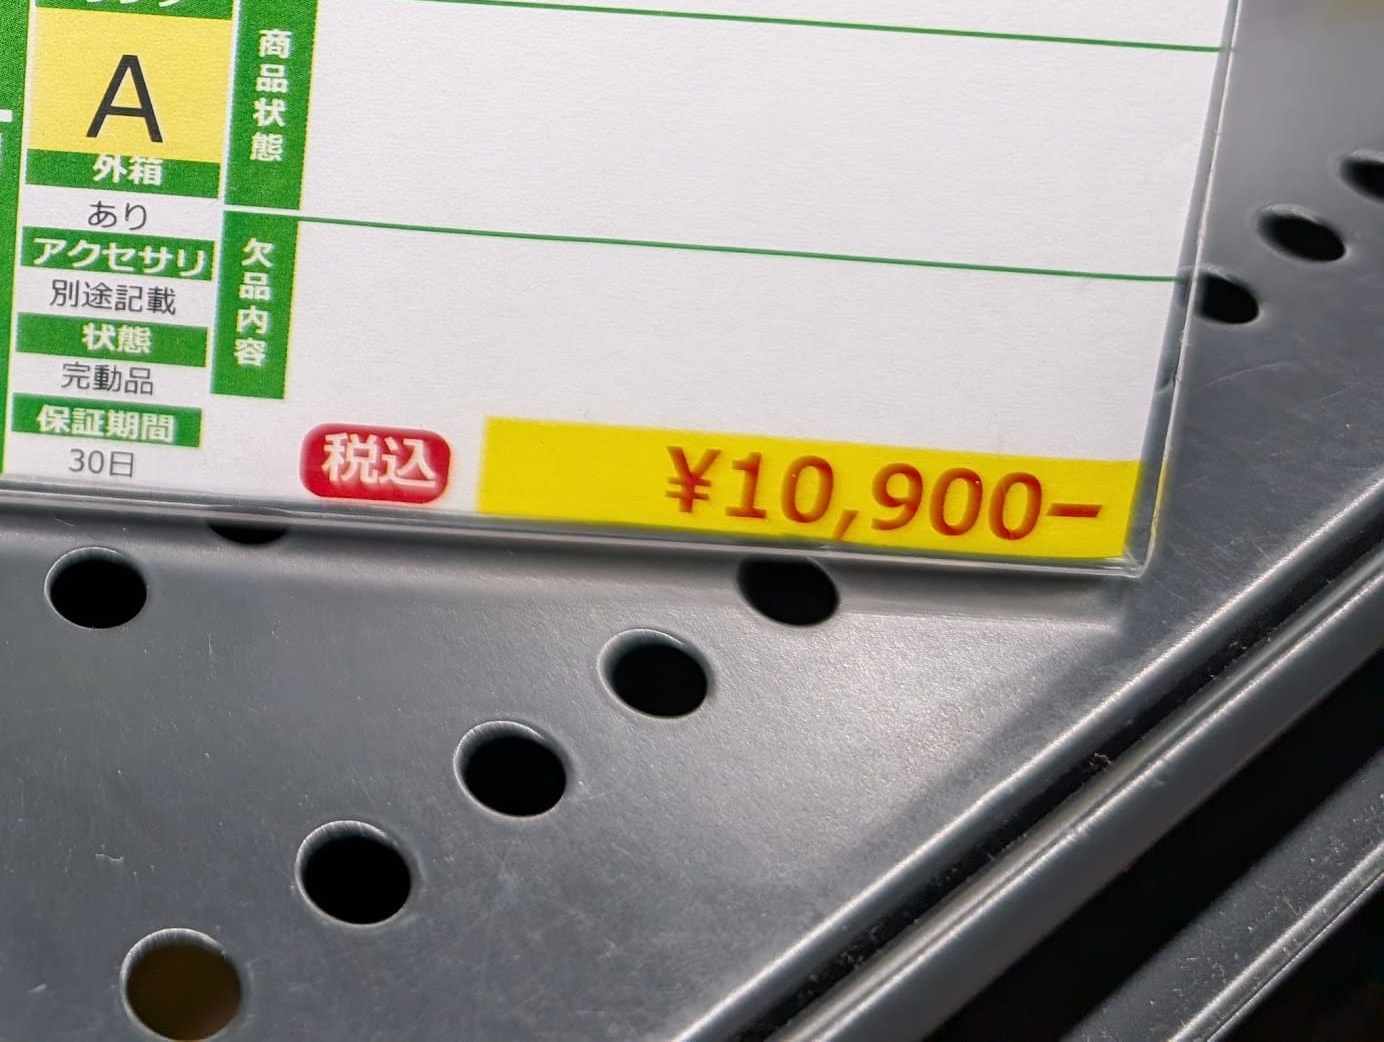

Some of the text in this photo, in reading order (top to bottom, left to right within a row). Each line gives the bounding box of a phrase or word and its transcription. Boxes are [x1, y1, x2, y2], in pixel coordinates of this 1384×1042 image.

[85, 53, 164, 144] A
[249, 28, 293, 163] 商品状態
[92, 154, 164, 187] 外箱
[88, 201, 148, 231] あり
[32, 236, 206, 279] アクセサリ
[50, 280, 176, 316] 別途記載
[234, 237, 273, 368] 欠品内容
[82, 323, 153, 355] 状態
[61, 362, 154, 396] 完動品
[36, 404, 176, 443] 保証期間
[68, 448, 135, 479] 30日
[322, 431, 436, 489] 税込
